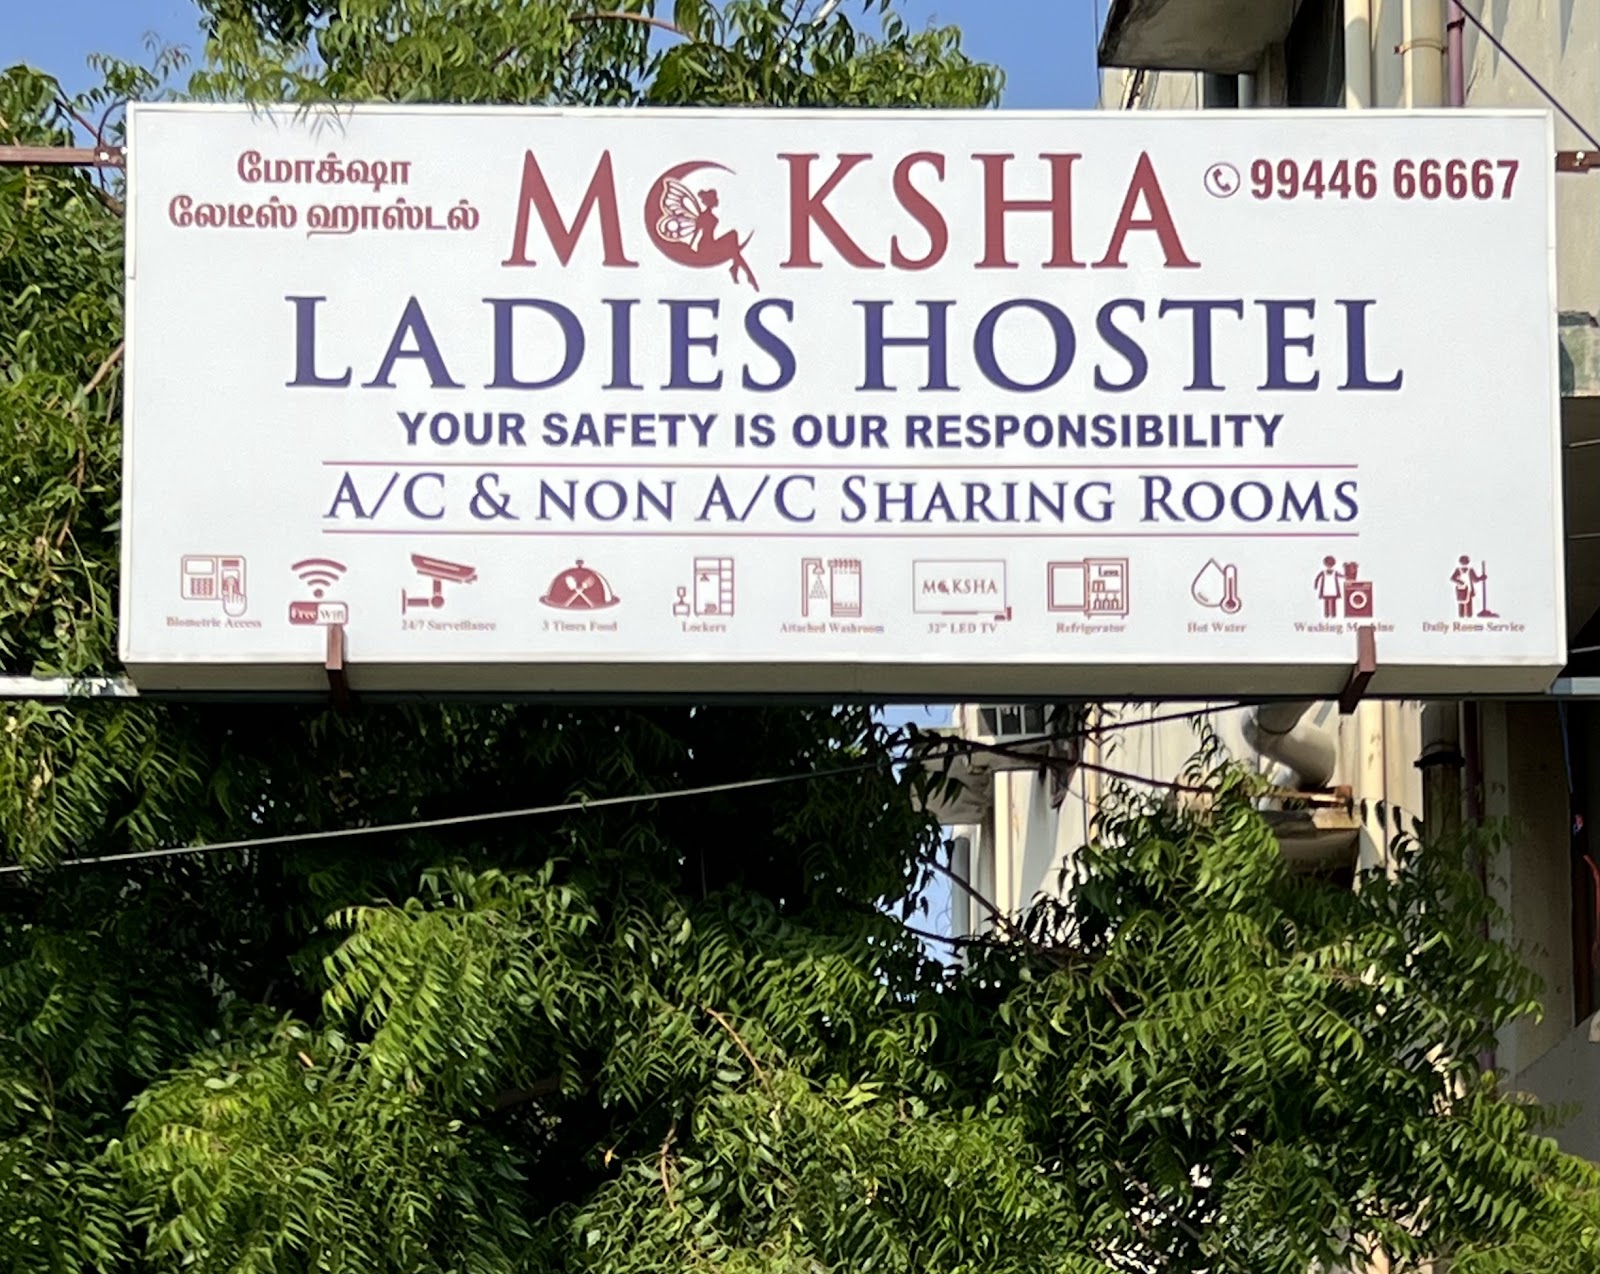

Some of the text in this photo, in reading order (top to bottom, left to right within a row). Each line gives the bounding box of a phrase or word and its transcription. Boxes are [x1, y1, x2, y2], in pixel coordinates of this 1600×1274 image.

[1250, 158, 1519, 200] 99446 66667
[168, 194, 480, 240] லேடீஸ் ஹாஸ்டல்
[500, 148, 1201, 293] MOKSHA
[284, 294, 1404, 392] LADIES HOSTEL
[397, 411, 1285, 449] YOUR SAFETY IS OUR RESPONSIBILITY
[321, 470, 446, 520] A/C
[468, 472, 520, 520] &
[534, 478, 677, 521] NON
[694, 473, 817, 523] A/C
[950, 622, 977, 634] LED
[981, 622, 998, 634] TV
